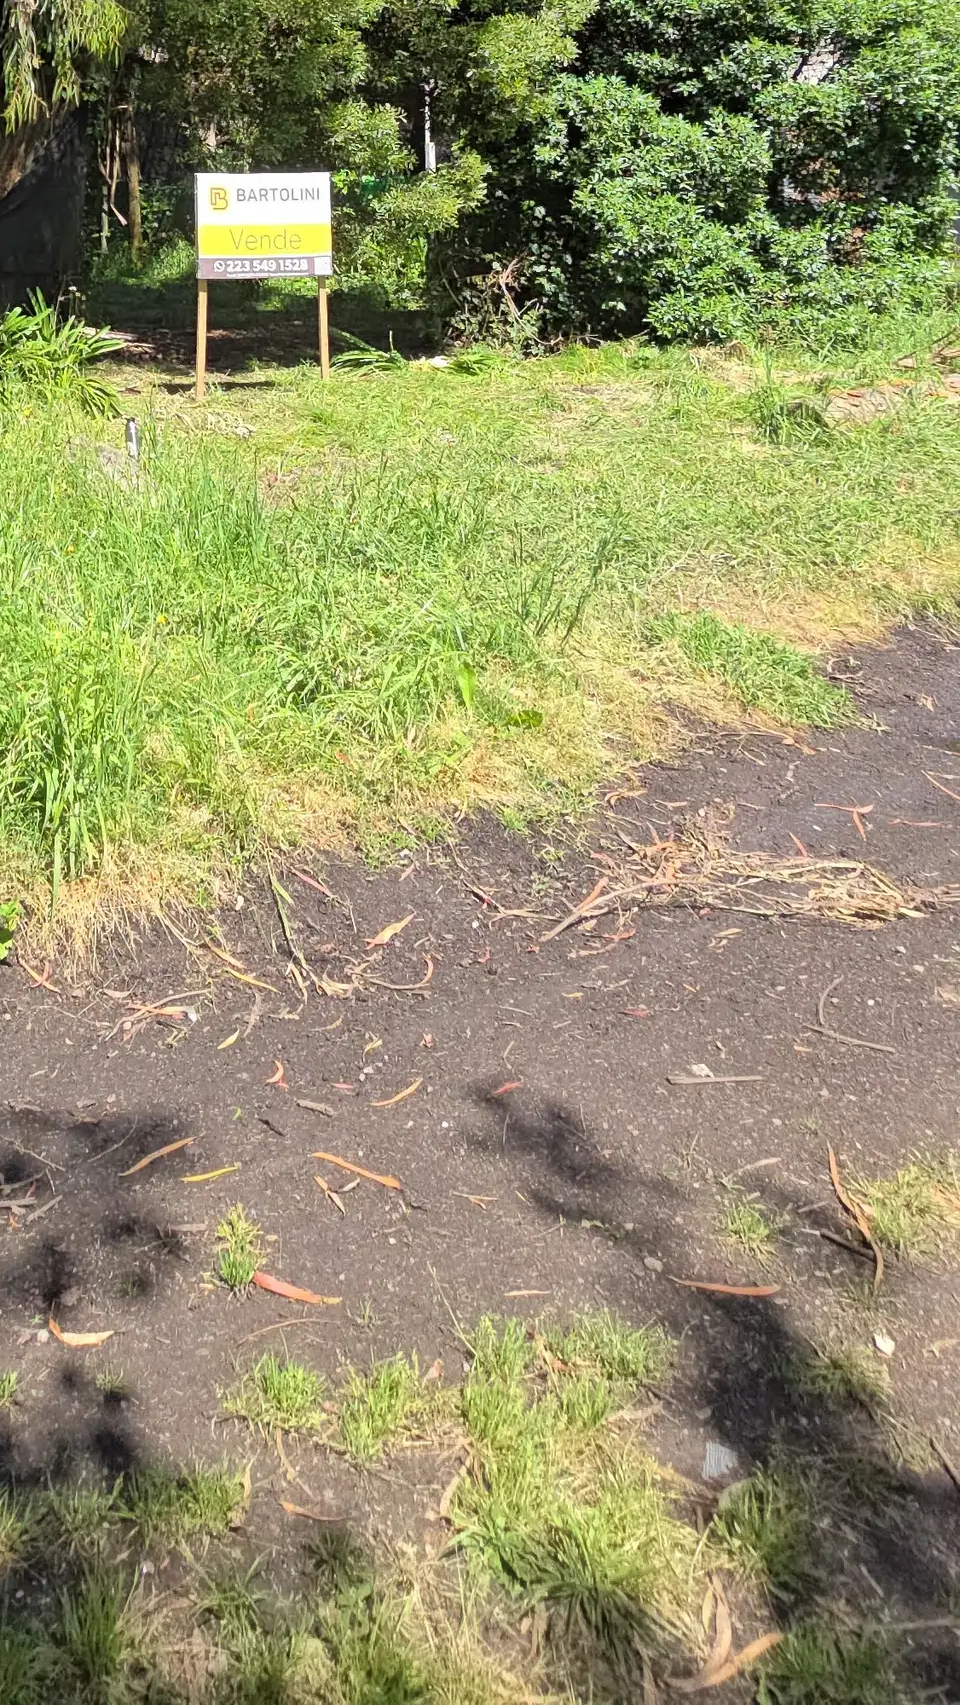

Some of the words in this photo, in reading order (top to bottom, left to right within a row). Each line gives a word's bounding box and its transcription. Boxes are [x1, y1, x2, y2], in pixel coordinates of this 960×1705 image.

[236, 187, 320, 202] BARTOLINI
[229, 228, 302, 250] Vende
[226, 260, 250, 272] 223
[253, 259, 276, 271] 549
[279, 258, 308, 271] 1528
